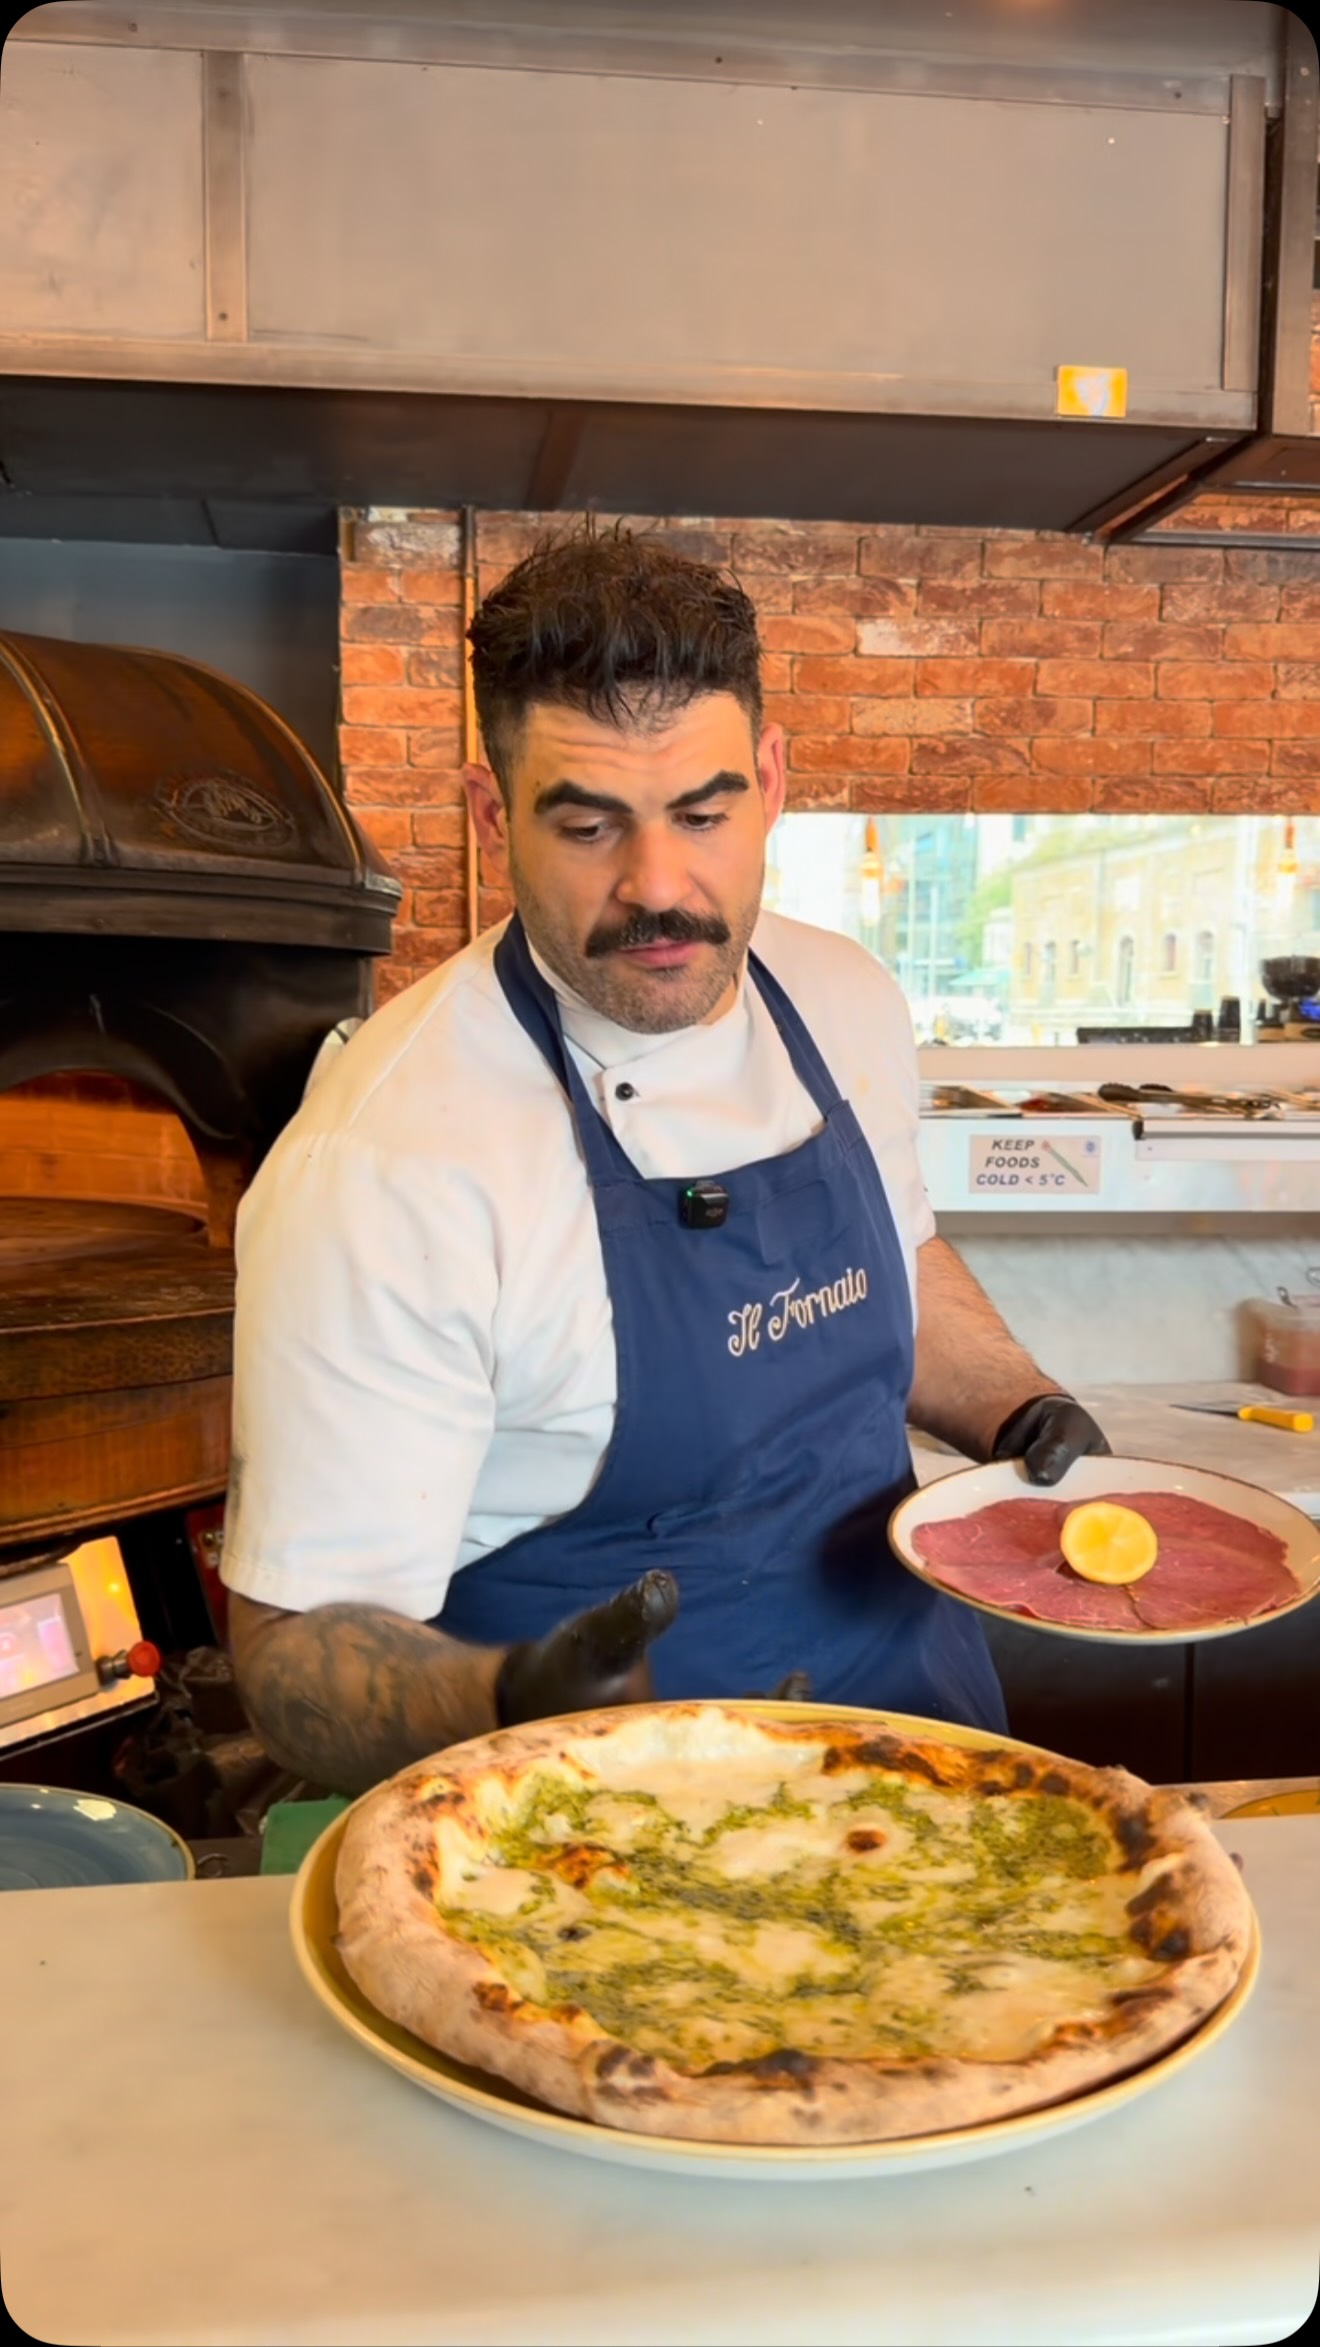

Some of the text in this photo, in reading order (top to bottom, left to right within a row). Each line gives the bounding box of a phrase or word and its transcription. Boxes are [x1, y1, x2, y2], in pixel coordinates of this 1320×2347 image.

[992, 1139, 1035, 1151] KEEP
[985, 1156, 1040, 1168] FOODS
[976, 1174, 1020, 1186] COLD
[728, 1267, 868, 1357] Il Fornaio
